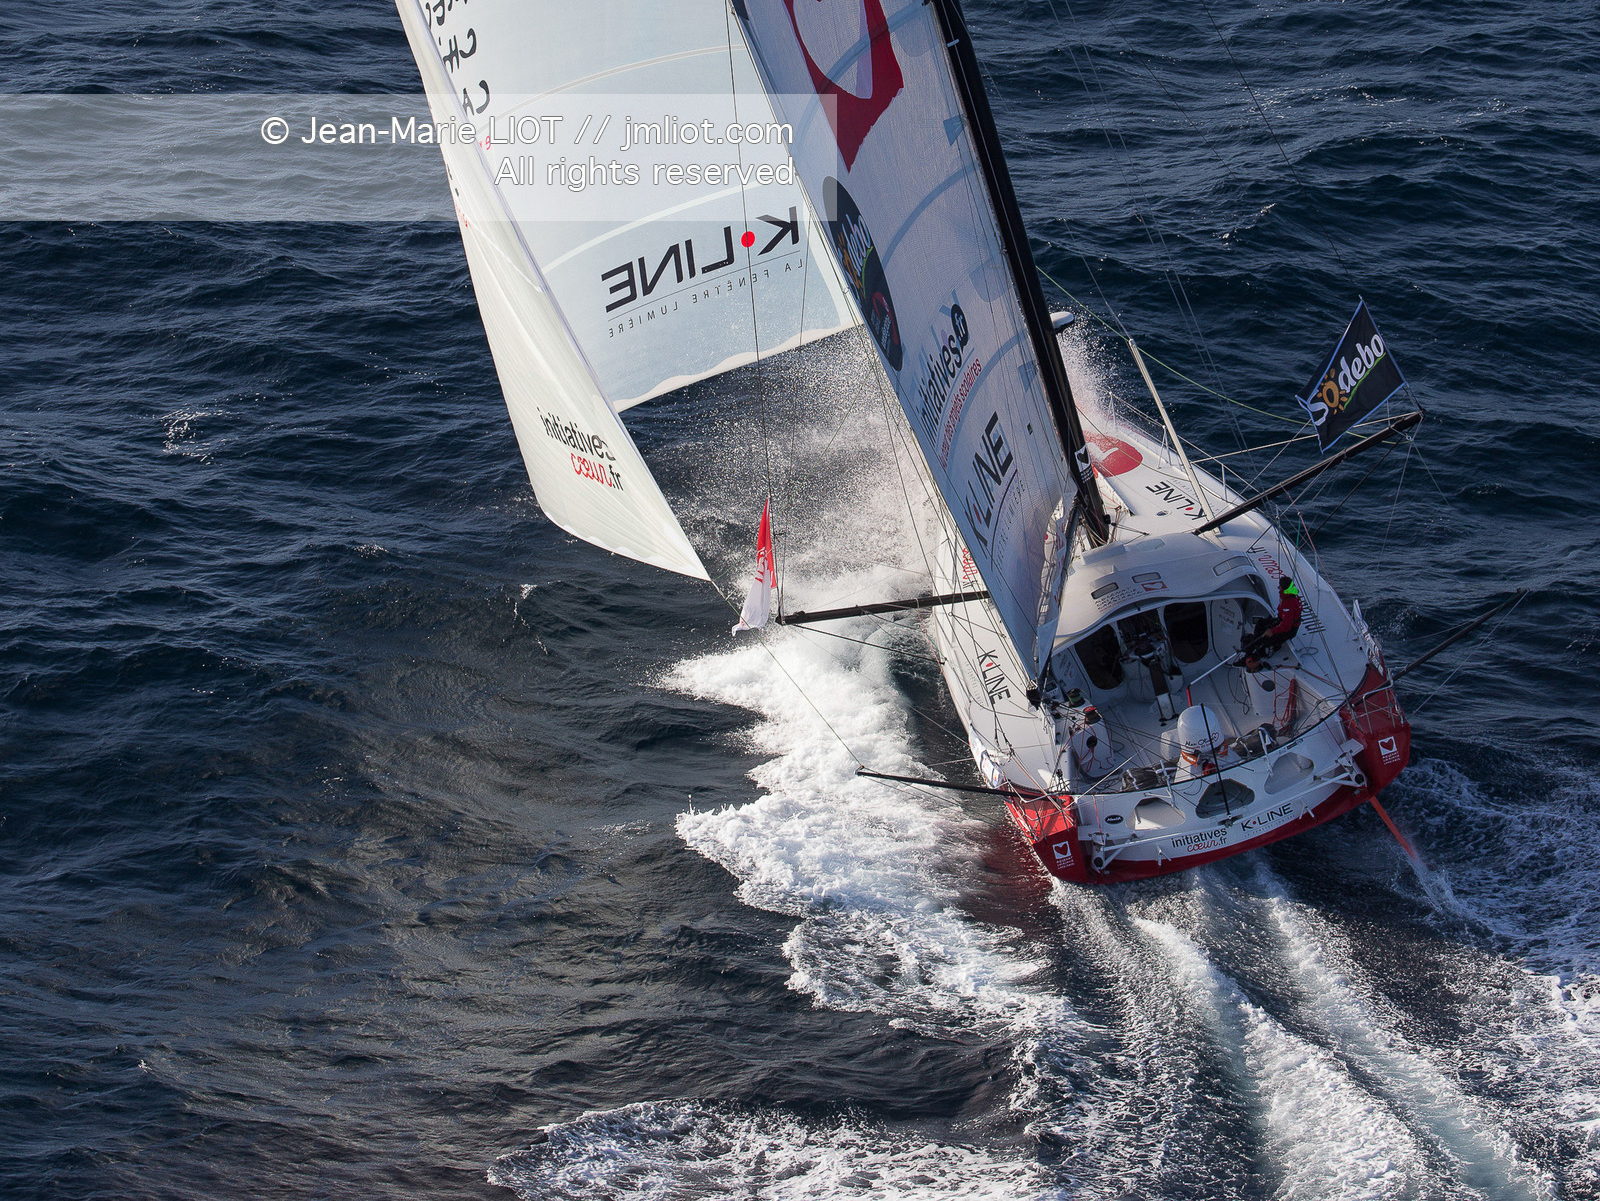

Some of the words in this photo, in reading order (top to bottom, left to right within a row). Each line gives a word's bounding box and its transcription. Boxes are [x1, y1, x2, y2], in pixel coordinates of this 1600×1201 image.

[1308, 334, 1384, 426] Sodebo
[537, 407, 616, 461] initiatives
[1171, 828, 1227, 848] initiatives
